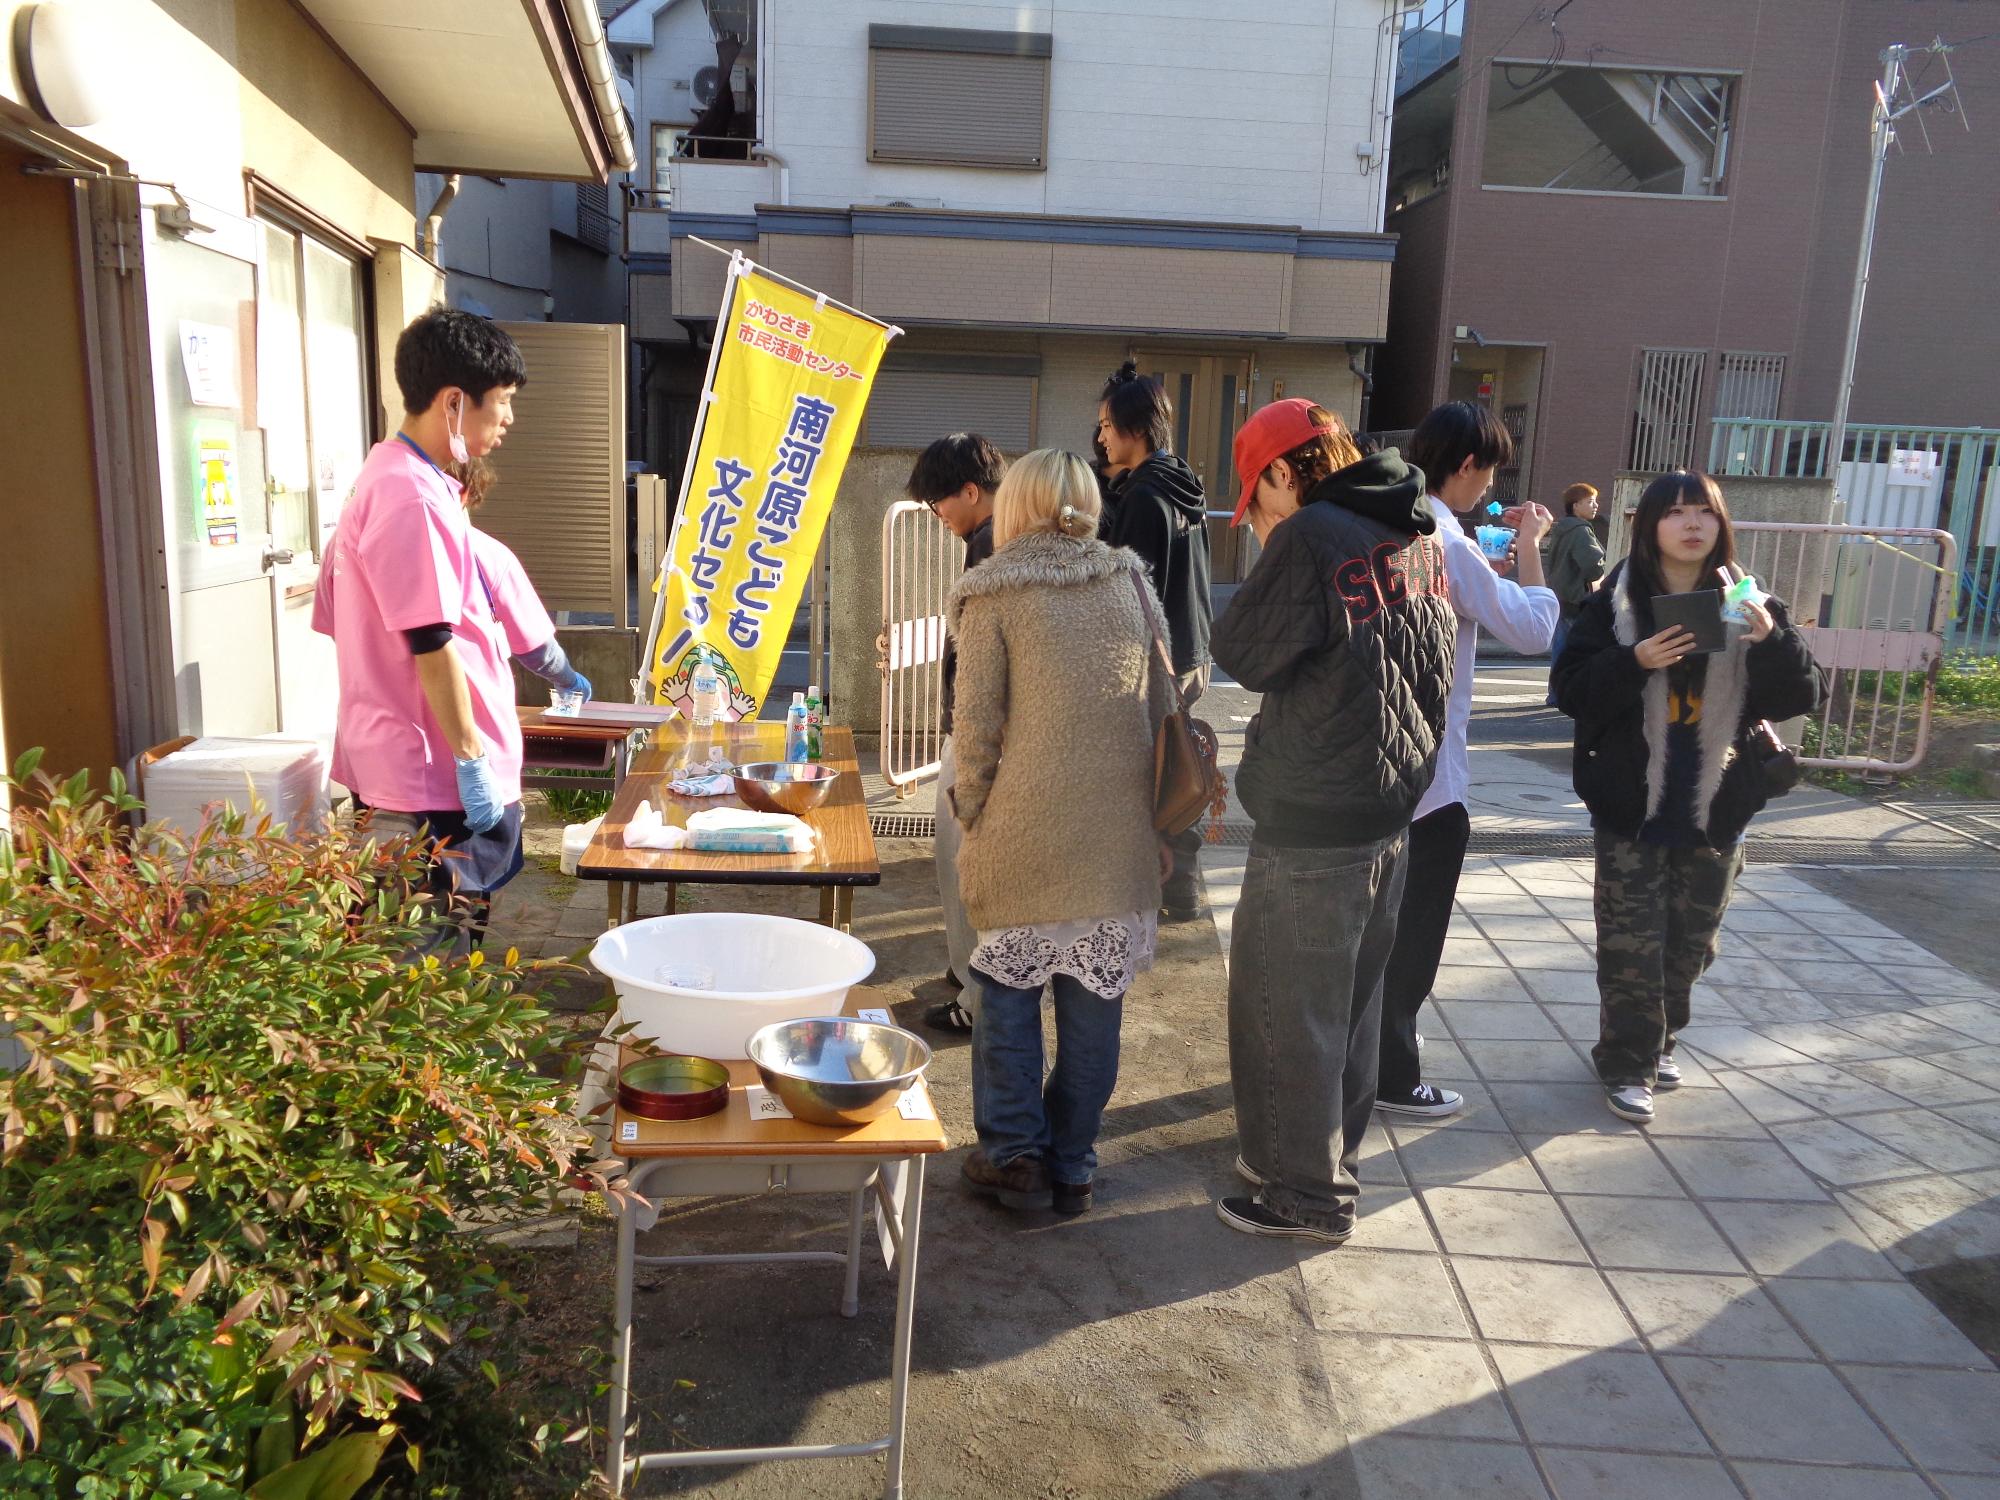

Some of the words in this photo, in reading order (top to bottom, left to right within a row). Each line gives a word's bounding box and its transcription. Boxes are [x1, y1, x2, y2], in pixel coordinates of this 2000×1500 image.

[745, 301, 812, 339] かわさき
[737, 324, 863, 381] 市民活動センター
[727, 395, 835, 649] 南河原こども
